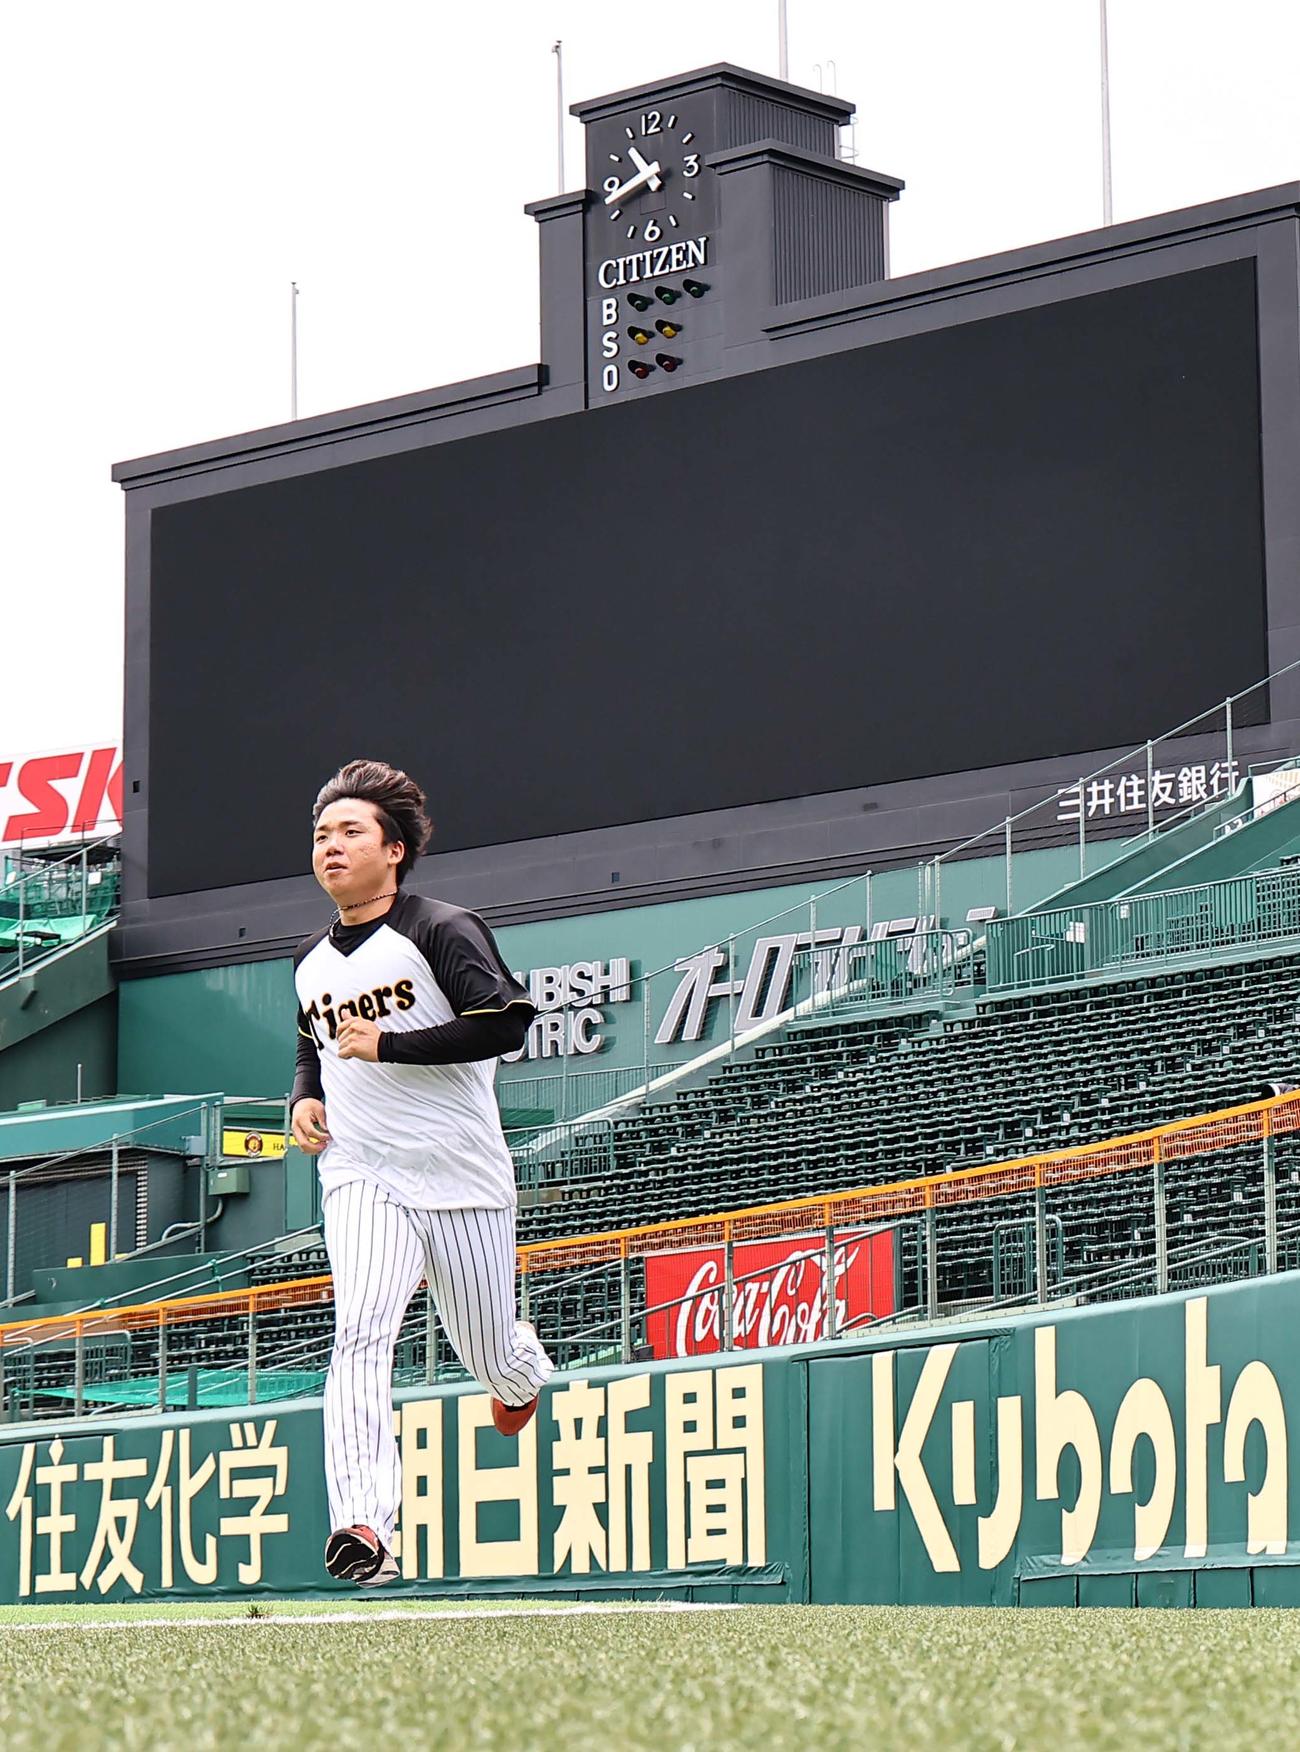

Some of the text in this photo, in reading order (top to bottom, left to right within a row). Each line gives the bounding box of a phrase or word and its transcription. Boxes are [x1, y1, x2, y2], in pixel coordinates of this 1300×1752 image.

[641, 111, 661, 136] 12
[603, 176, 620, 200] 9
[682, 153, 699, 177] 3
[643, 219, 661, 242] 6
[598, 237, 707, 289] CITIZEN
[602, 298, 618, 326] B
[602, 331, 618, 359] S
[0, 747, 124, 842] SK
[1057, 760, 1239, 821] 三井住友銀行
[501, 1008, 604, 1063] TRIC
[676, 1246, 860, 1357] Coca-Cola
[872, 1296, 1289, 1573] Kubota
[6, 1419, 289, 1597] 住友化学
